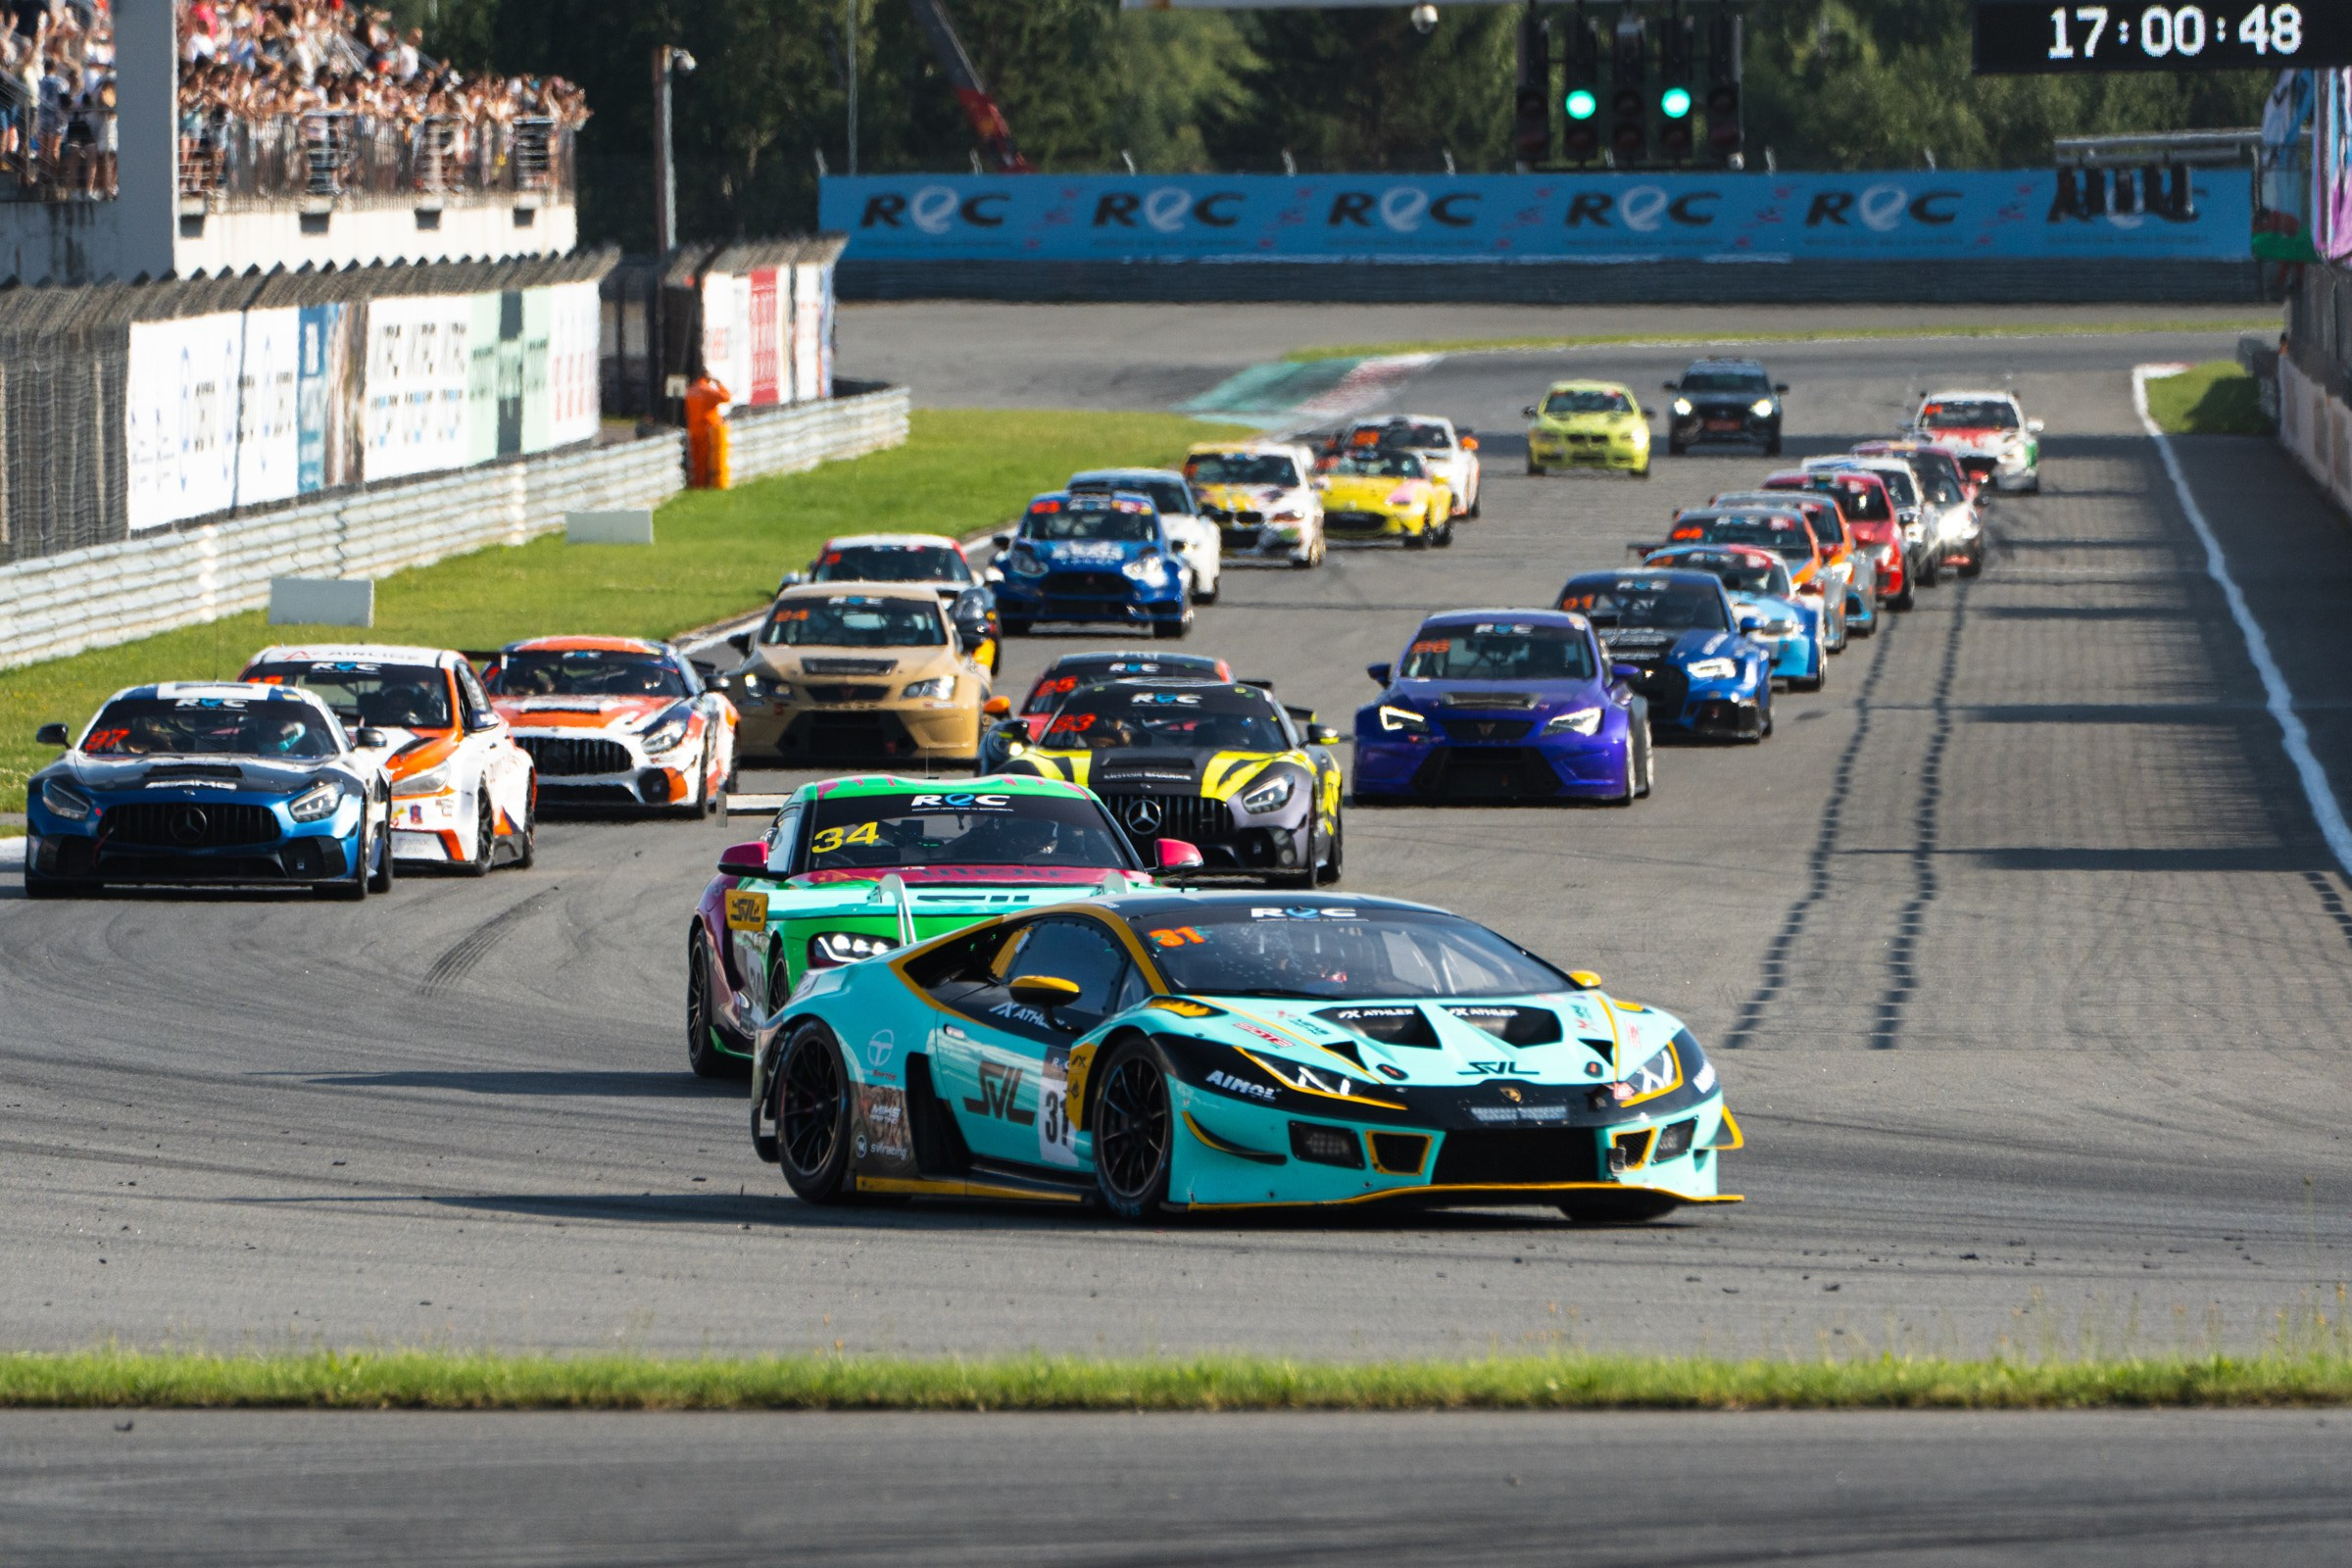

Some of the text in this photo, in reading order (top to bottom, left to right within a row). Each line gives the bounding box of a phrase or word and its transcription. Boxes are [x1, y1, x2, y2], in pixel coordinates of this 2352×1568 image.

[2048, 3, 2302, 59] 17:00:48
[85, 728, 130, 752] 97
[811, 821, 879, 854] 34
[1149, 925, 1205, 948] 31
[1456, 1061, 1541, 1075] SVL
[962, 1060, 1035, 1127] SVL
[1205, 1069, 1276, 1101] AIMOL
